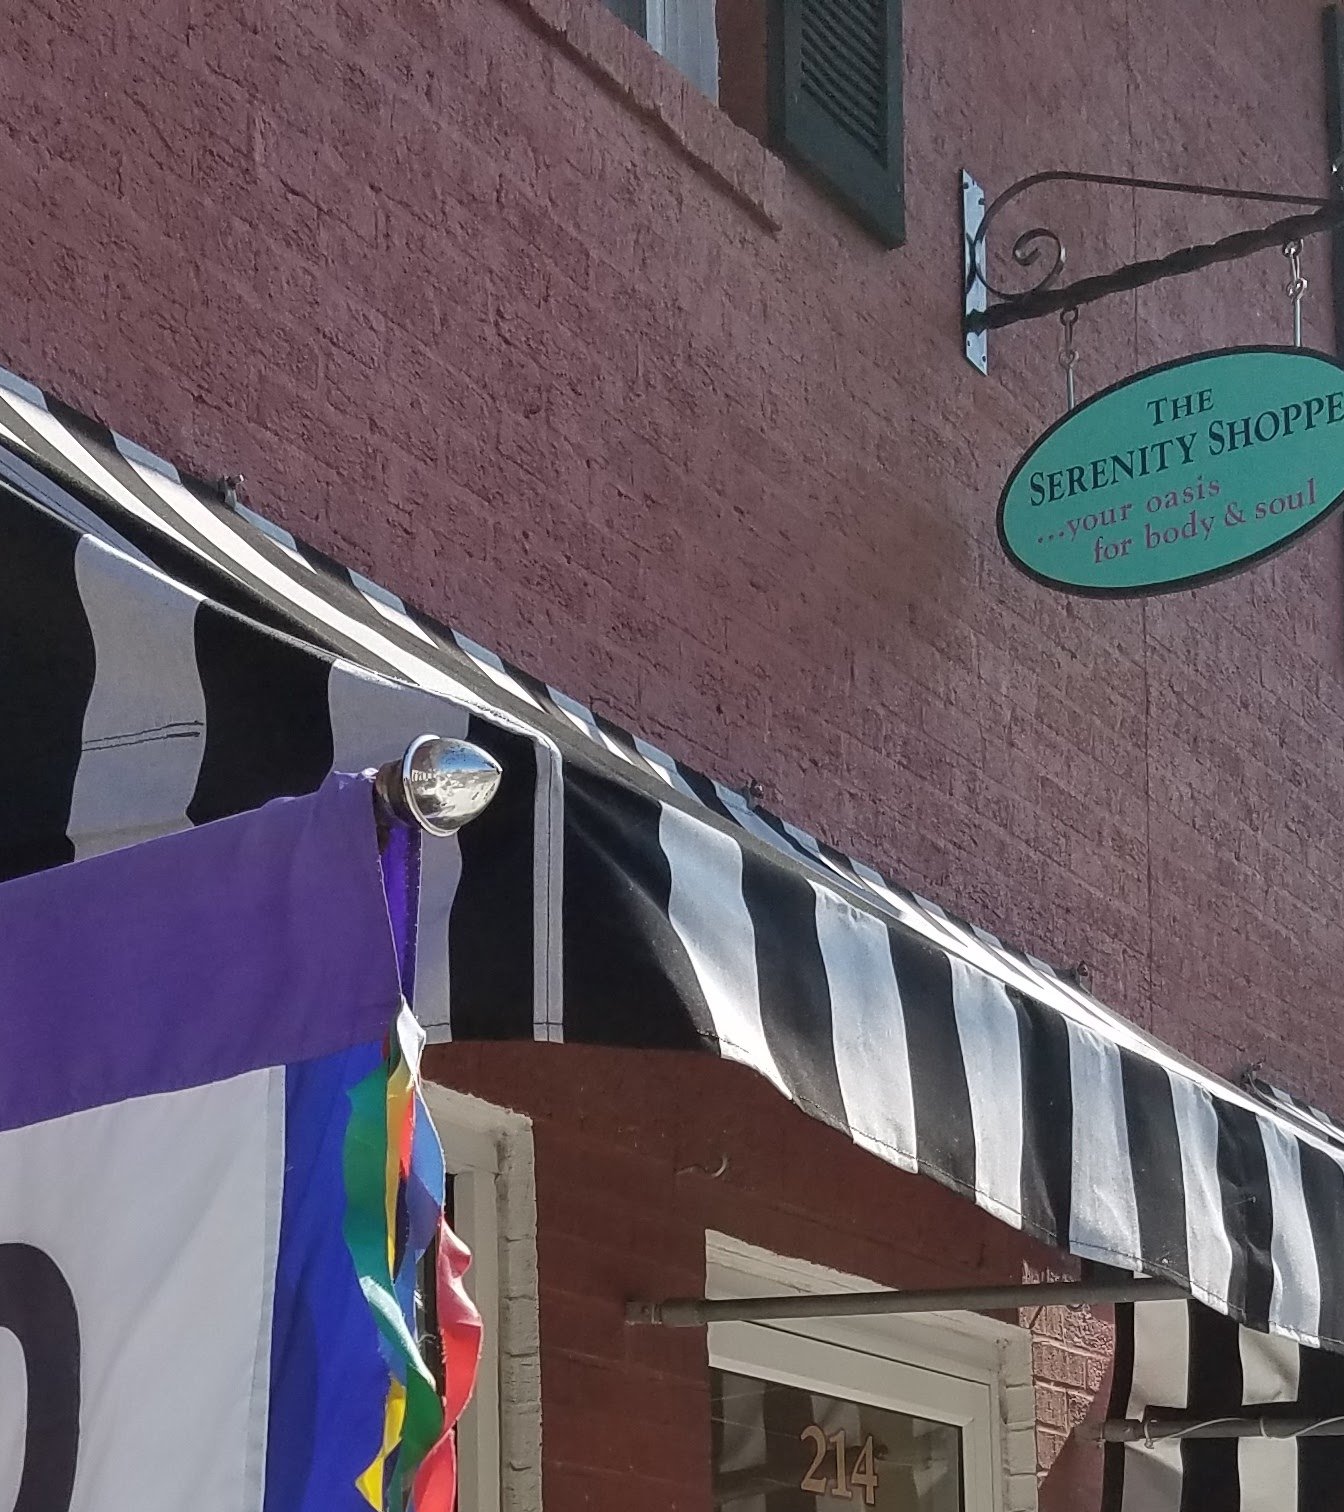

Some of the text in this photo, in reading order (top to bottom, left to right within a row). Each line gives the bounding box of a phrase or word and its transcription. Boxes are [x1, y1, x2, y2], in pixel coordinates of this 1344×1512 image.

[1147, 388, 1215, 427] THE
[1029, 432, 1198, 507] SERENITY
[1146, 475, 1221, 515] oasis
[1093, 478, 1317, 564] for body & soul
[799, 1424, 878, 1506] 214
